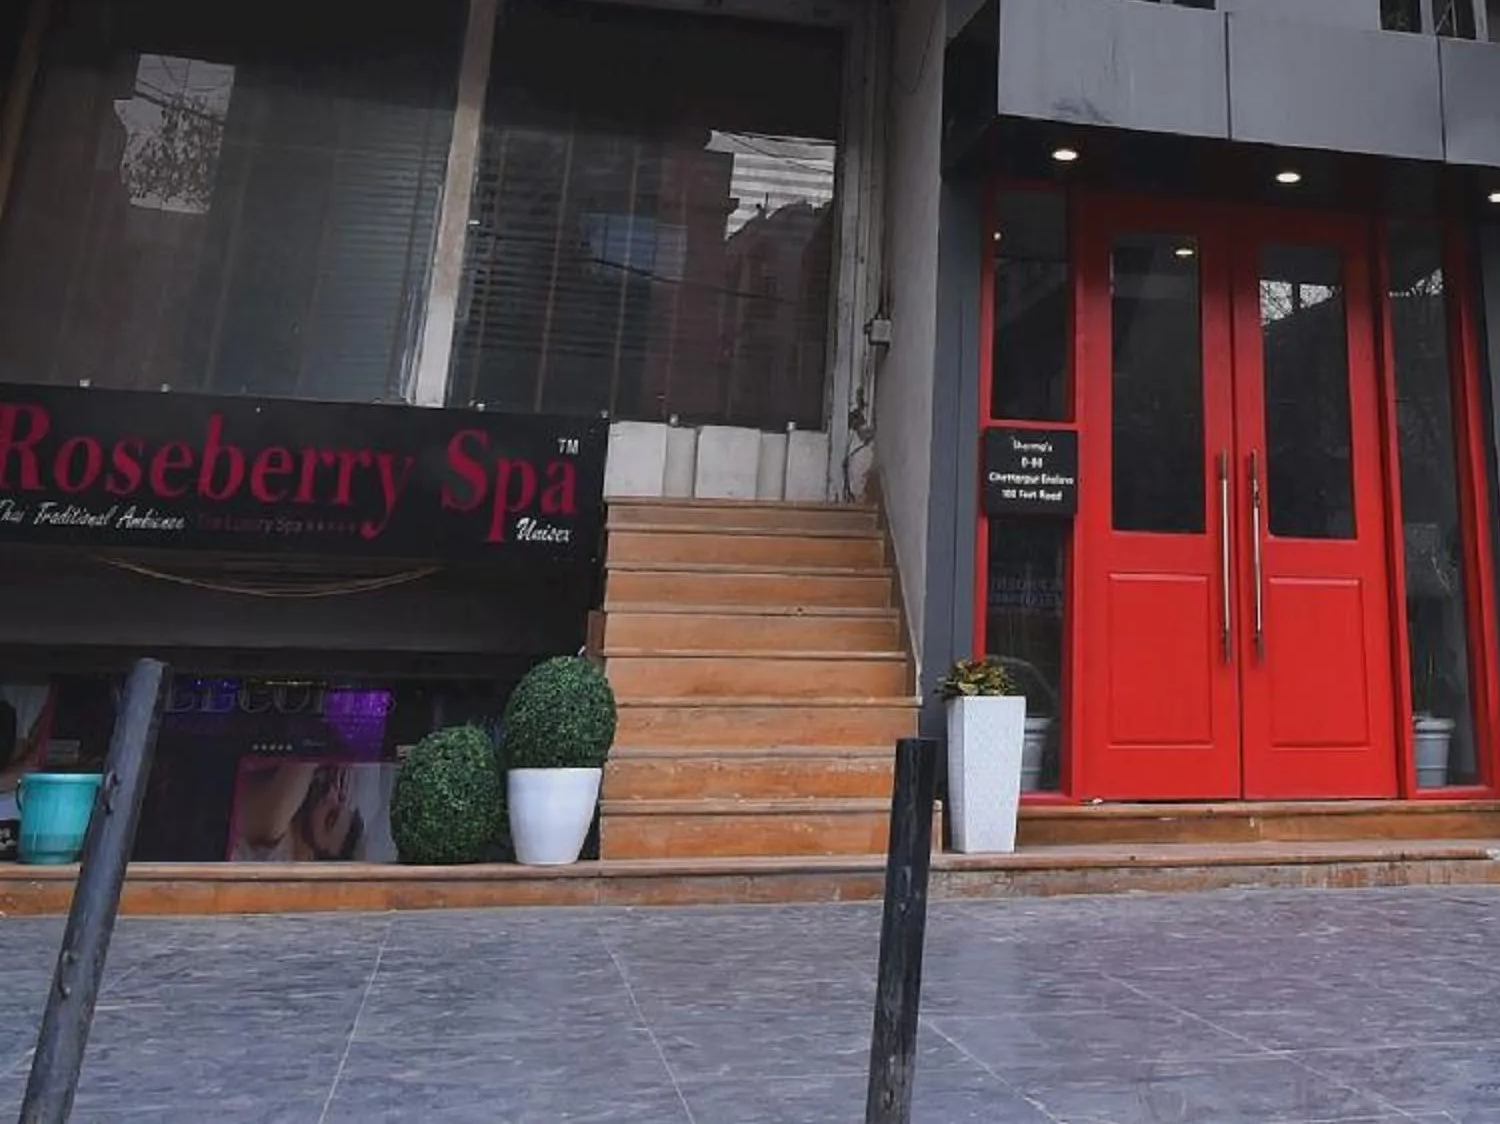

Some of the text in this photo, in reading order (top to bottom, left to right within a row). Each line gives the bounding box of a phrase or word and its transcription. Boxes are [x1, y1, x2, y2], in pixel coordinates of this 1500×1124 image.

[557, 438, 580, 455] TM
[0, 401, 580, 544] Roseberry Spa
[515, 517, 574, 544] Unisex
